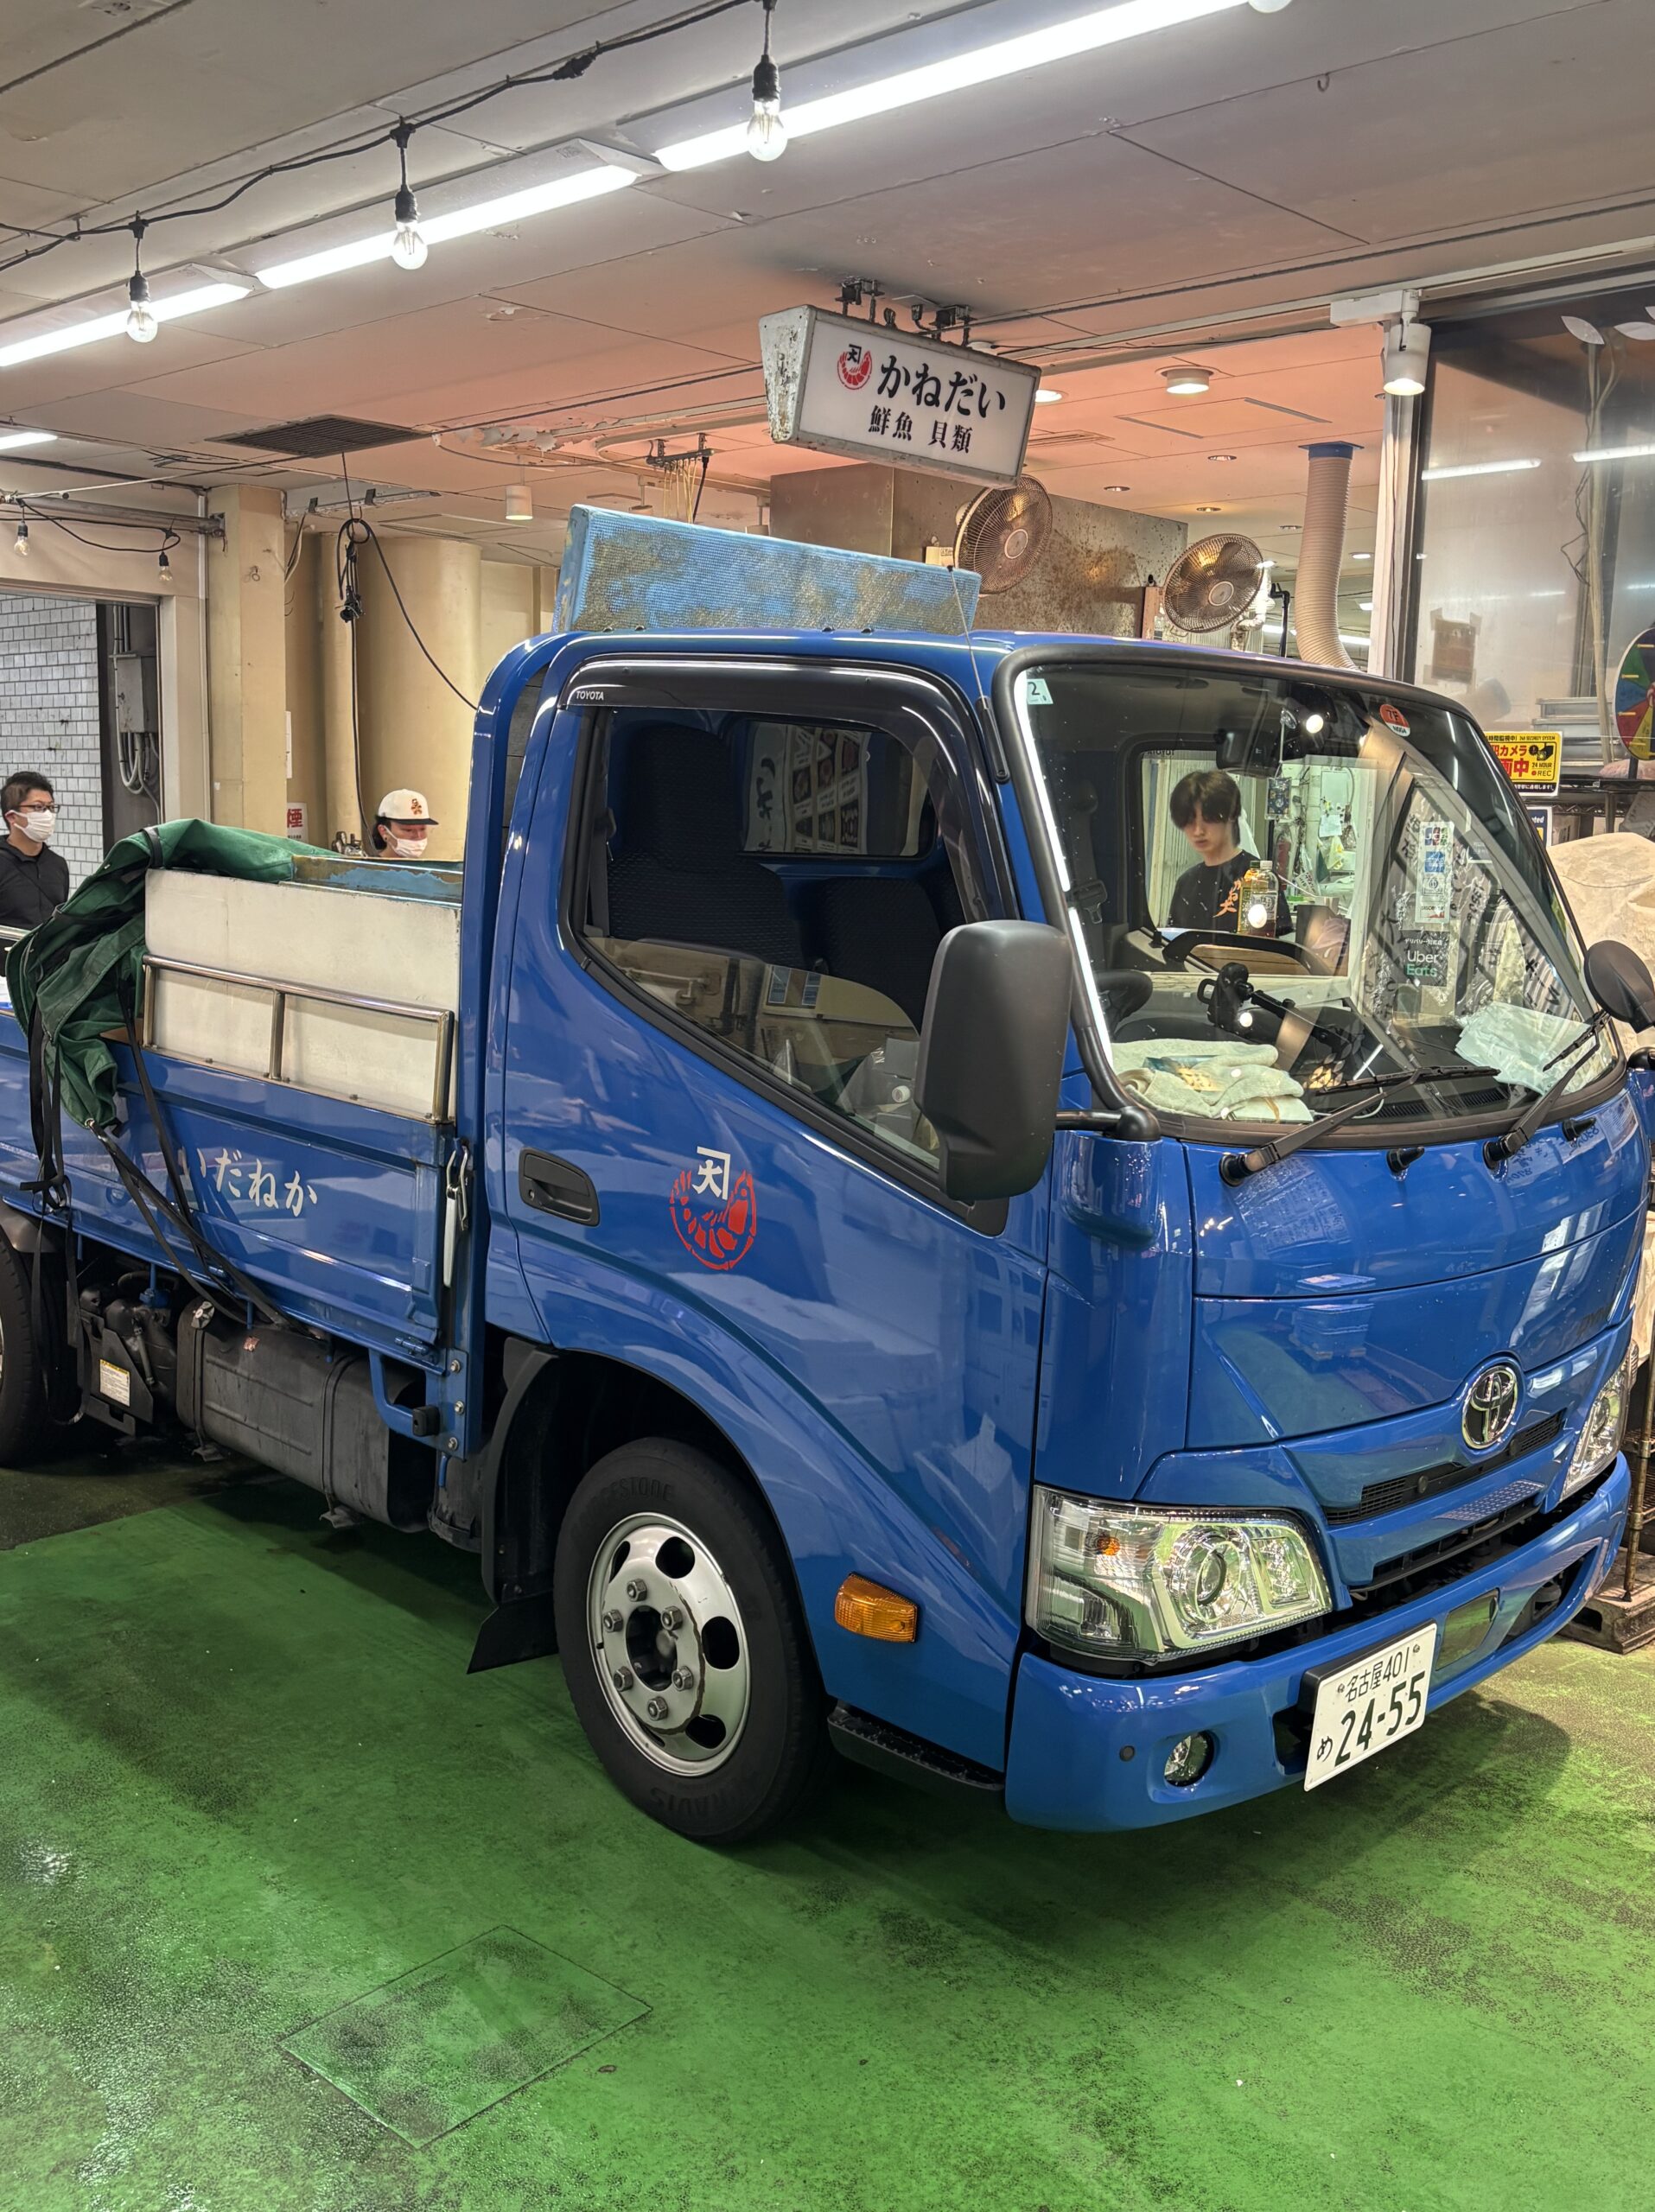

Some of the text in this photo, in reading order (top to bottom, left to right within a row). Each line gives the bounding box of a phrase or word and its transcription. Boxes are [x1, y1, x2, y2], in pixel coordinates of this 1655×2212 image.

[877, 354, 1006, 418] かねだい
[868, 404, 973, 454] 鮮魚 貝類
[576, 690, 604, 700] TOYOTA
[1406, 963, 1438, 977] Eats
[1407, 950, 1440, 963] Uber
[1316, 1670, 1426, 1768] め 24-55
